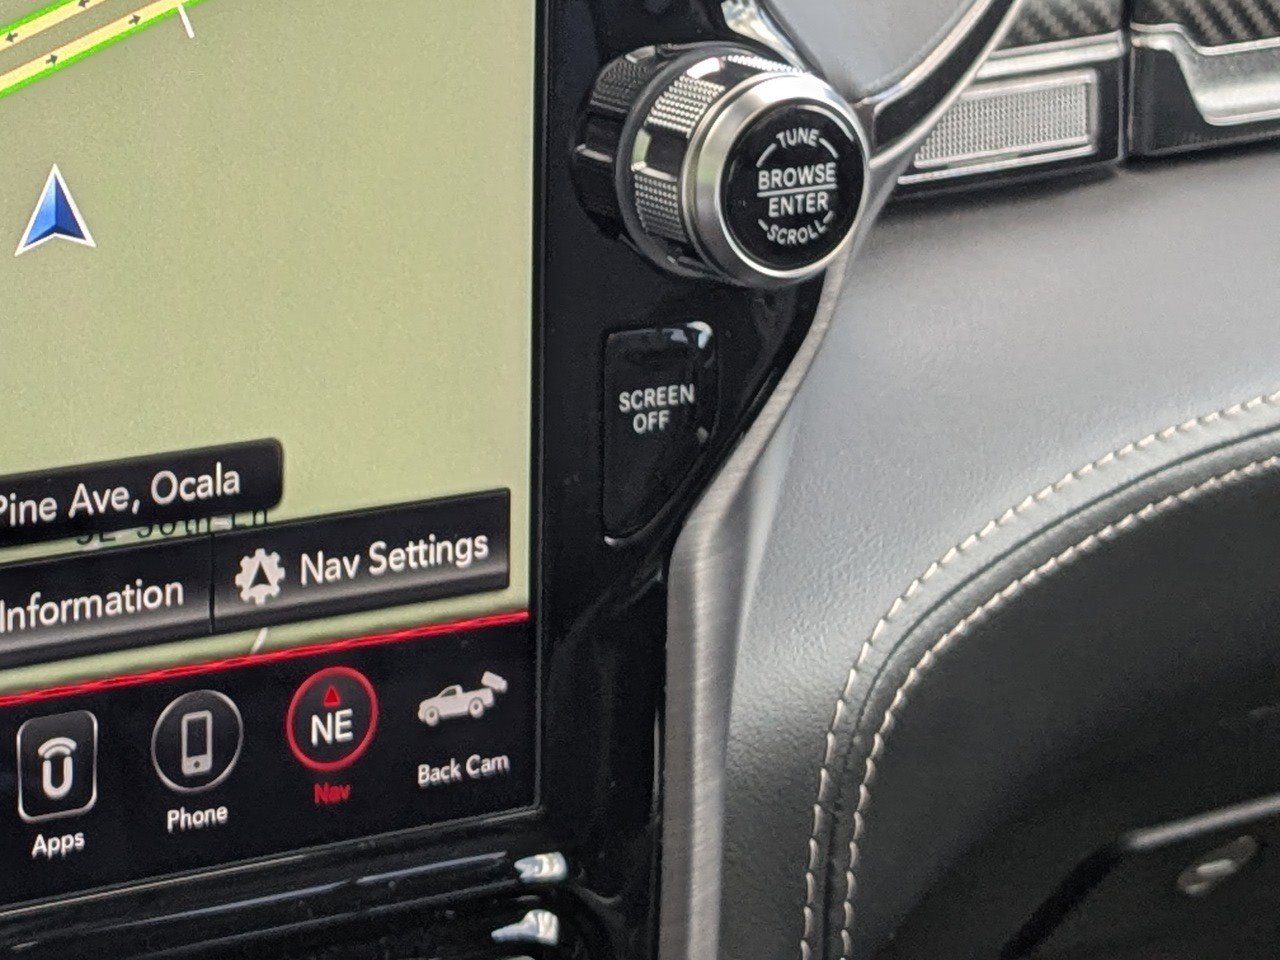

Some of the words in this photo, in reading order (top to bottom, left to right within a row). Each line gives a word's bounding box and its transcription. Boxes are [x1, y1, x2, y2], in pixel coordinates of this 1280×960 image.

[777, 127, 820, 148] TUNE
[758, 163, 837, 189] BROWSE
[768, 191, 829, 218] ENTER
[766, 219, 827, 245] SCROLL
[619, 384, 695, 414] SCREEN
[633, 410, 670, 435] OFF
[68, 482, 141, 519] Ave,
[150, 461, 241, 505] Ocala
[299, 552, 360, 586] Nav
[368, 533, 490, 576] Settings
[310, 708, 354, 746] NE
[418, 761, 461, 787] Back
[466, 752, 510, 777] Cam
[314, 782, 351, 805] Nav
[167, 804, 228, 833] Phone
[31, 829, 85, 859] Apps
